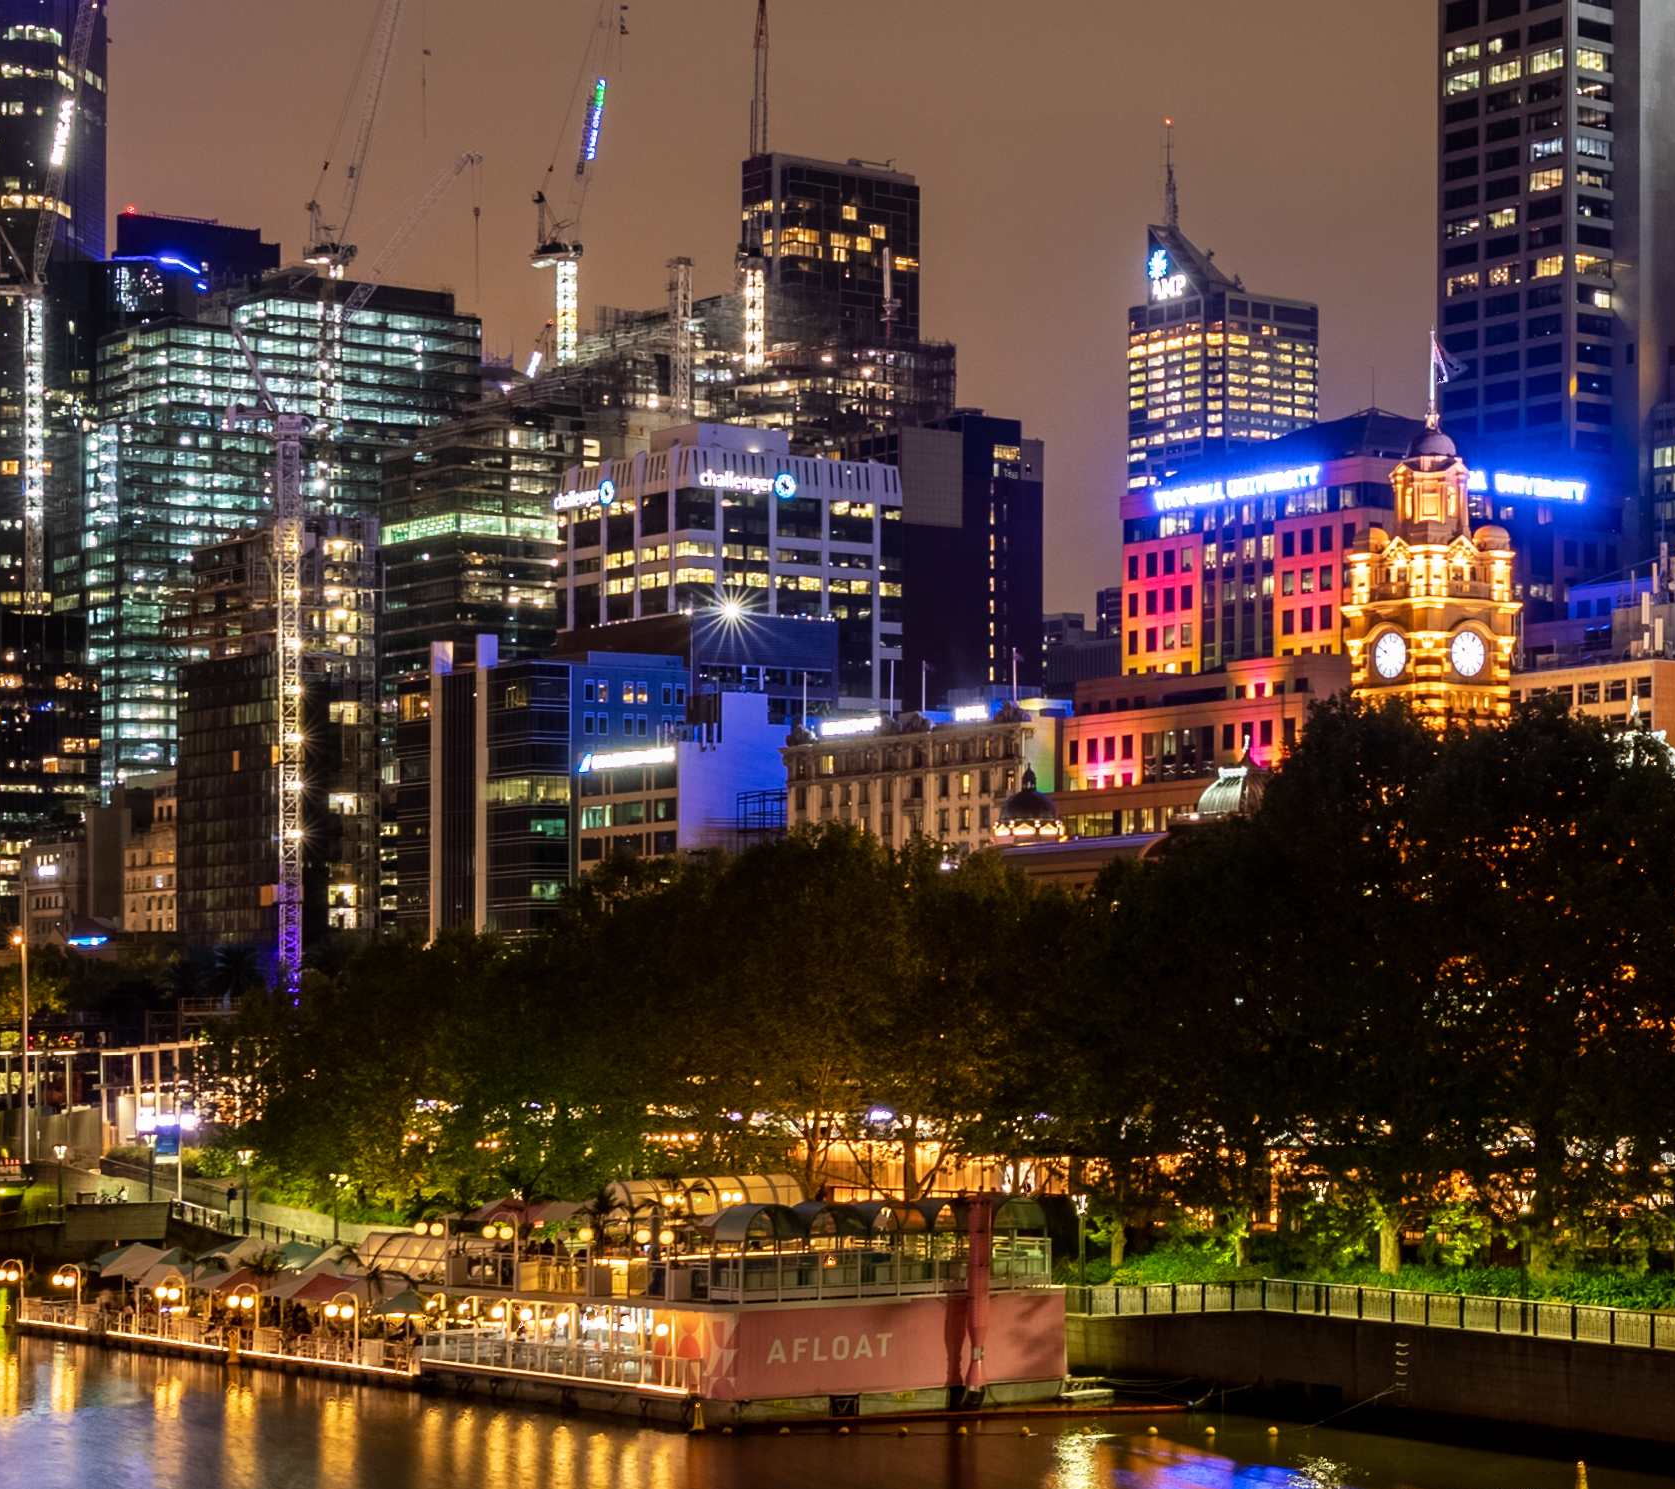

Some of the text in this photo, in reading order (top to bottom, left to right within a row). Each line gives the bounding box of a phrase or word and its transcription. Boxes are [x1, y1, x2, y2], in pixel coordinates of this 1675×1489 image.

[1152, 274, 1186, 300] AMP
[699, 468, 774, 496] challenger
[1226, 465, 1320, 499] UNIVERSITY
[553, 488, 600, 511] challenger
[766, 1332, 893, 1365] AFLOAT
